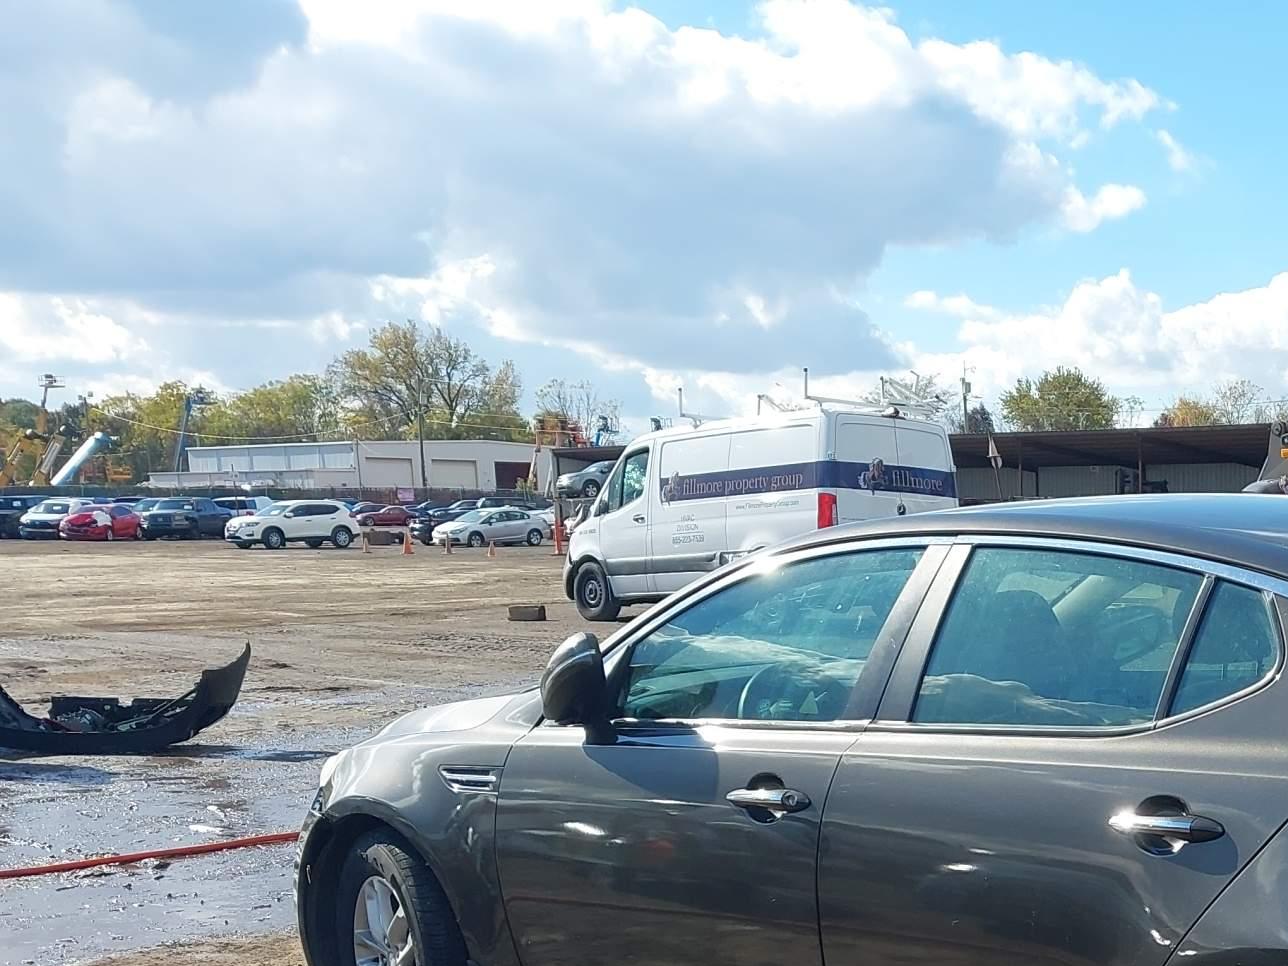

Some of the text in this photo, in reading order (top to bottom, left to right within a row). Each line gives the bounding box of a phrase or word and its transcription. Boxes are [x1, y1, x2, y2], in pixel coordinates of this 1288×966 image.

[683, 473, 804, 496] fillmore property group
[891, 469, 943, 490] fillmore
